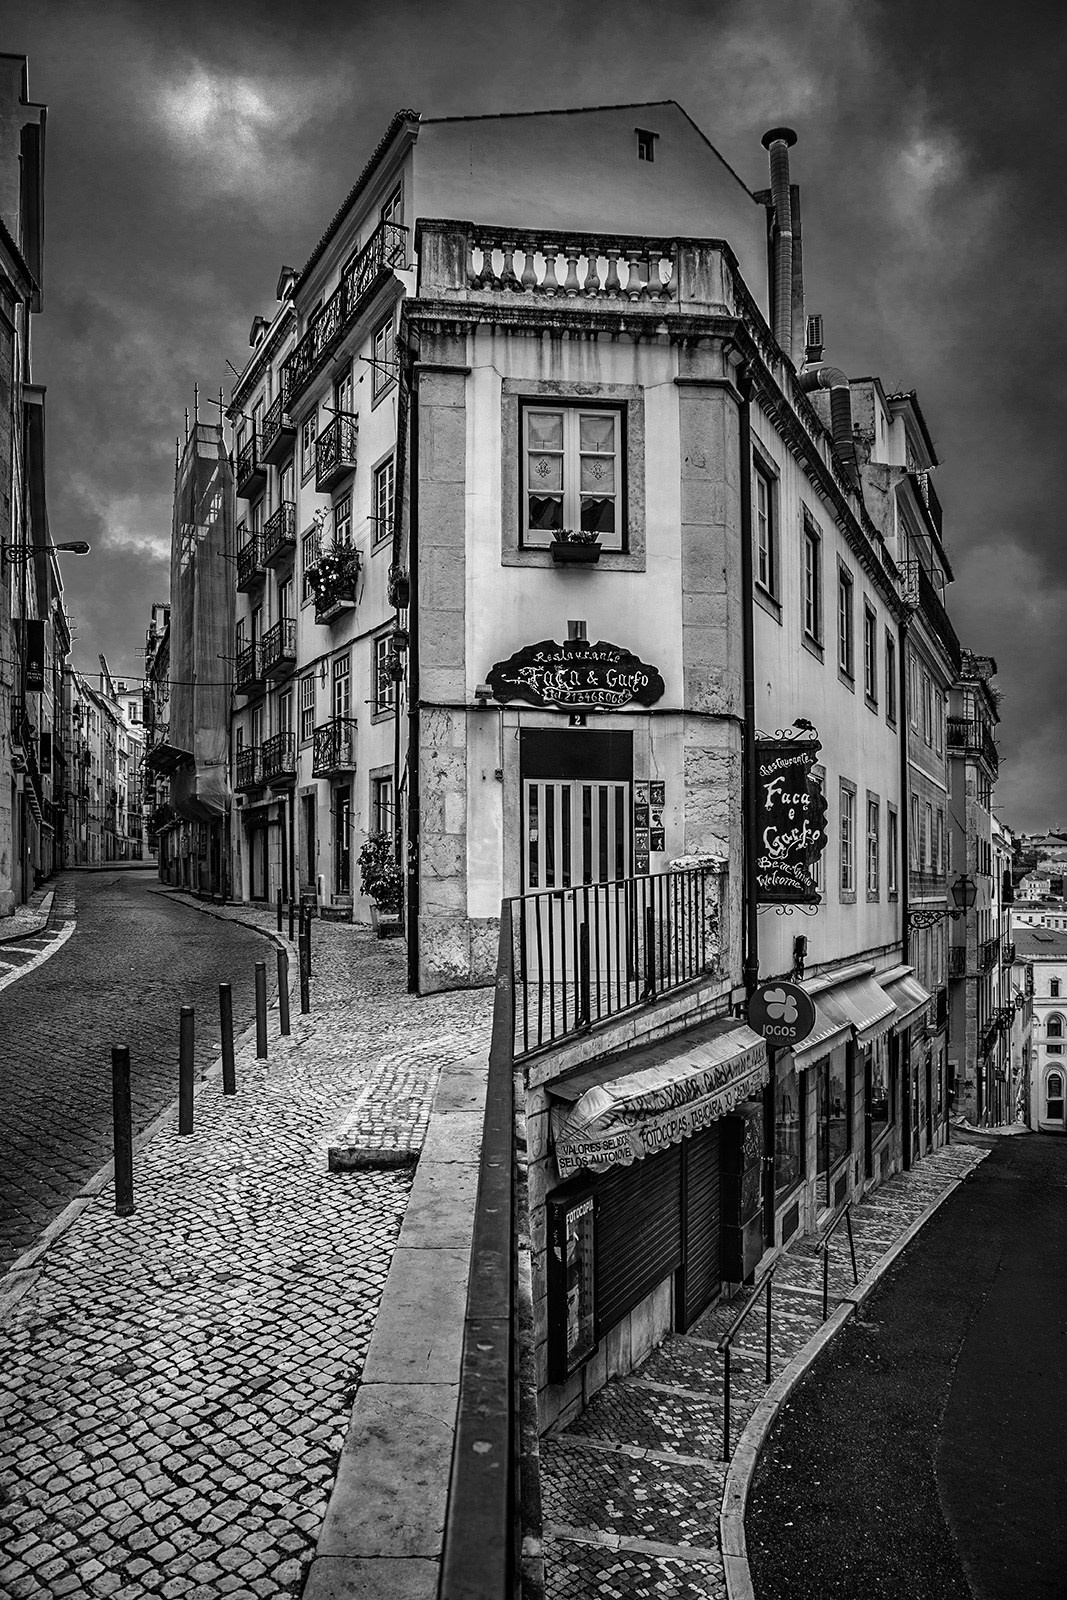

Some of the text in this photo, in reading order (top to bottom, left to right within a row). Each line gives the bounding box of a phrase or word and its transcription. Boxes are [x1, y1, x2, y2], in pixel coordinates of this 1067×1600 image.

[533, 649, 620, 663] Restaurante
[587, 670, 598, 685] &
[606, 668, 649, 692] Garfo
[573, 714, 582, 726] 2
[759, 752, 813, 777] Restaurante
[763, 776, 811, 811] Faca
[788, 808, 795, 820] e
[763, 819, 820, 859] Garfo
[756, 870, 804, 891] Welcome
[762, 1024, 796, 1037] JOGOS
[561, 1143, 601, 1155] VALORES
[559, 1156, 588, 1168] SELOS
